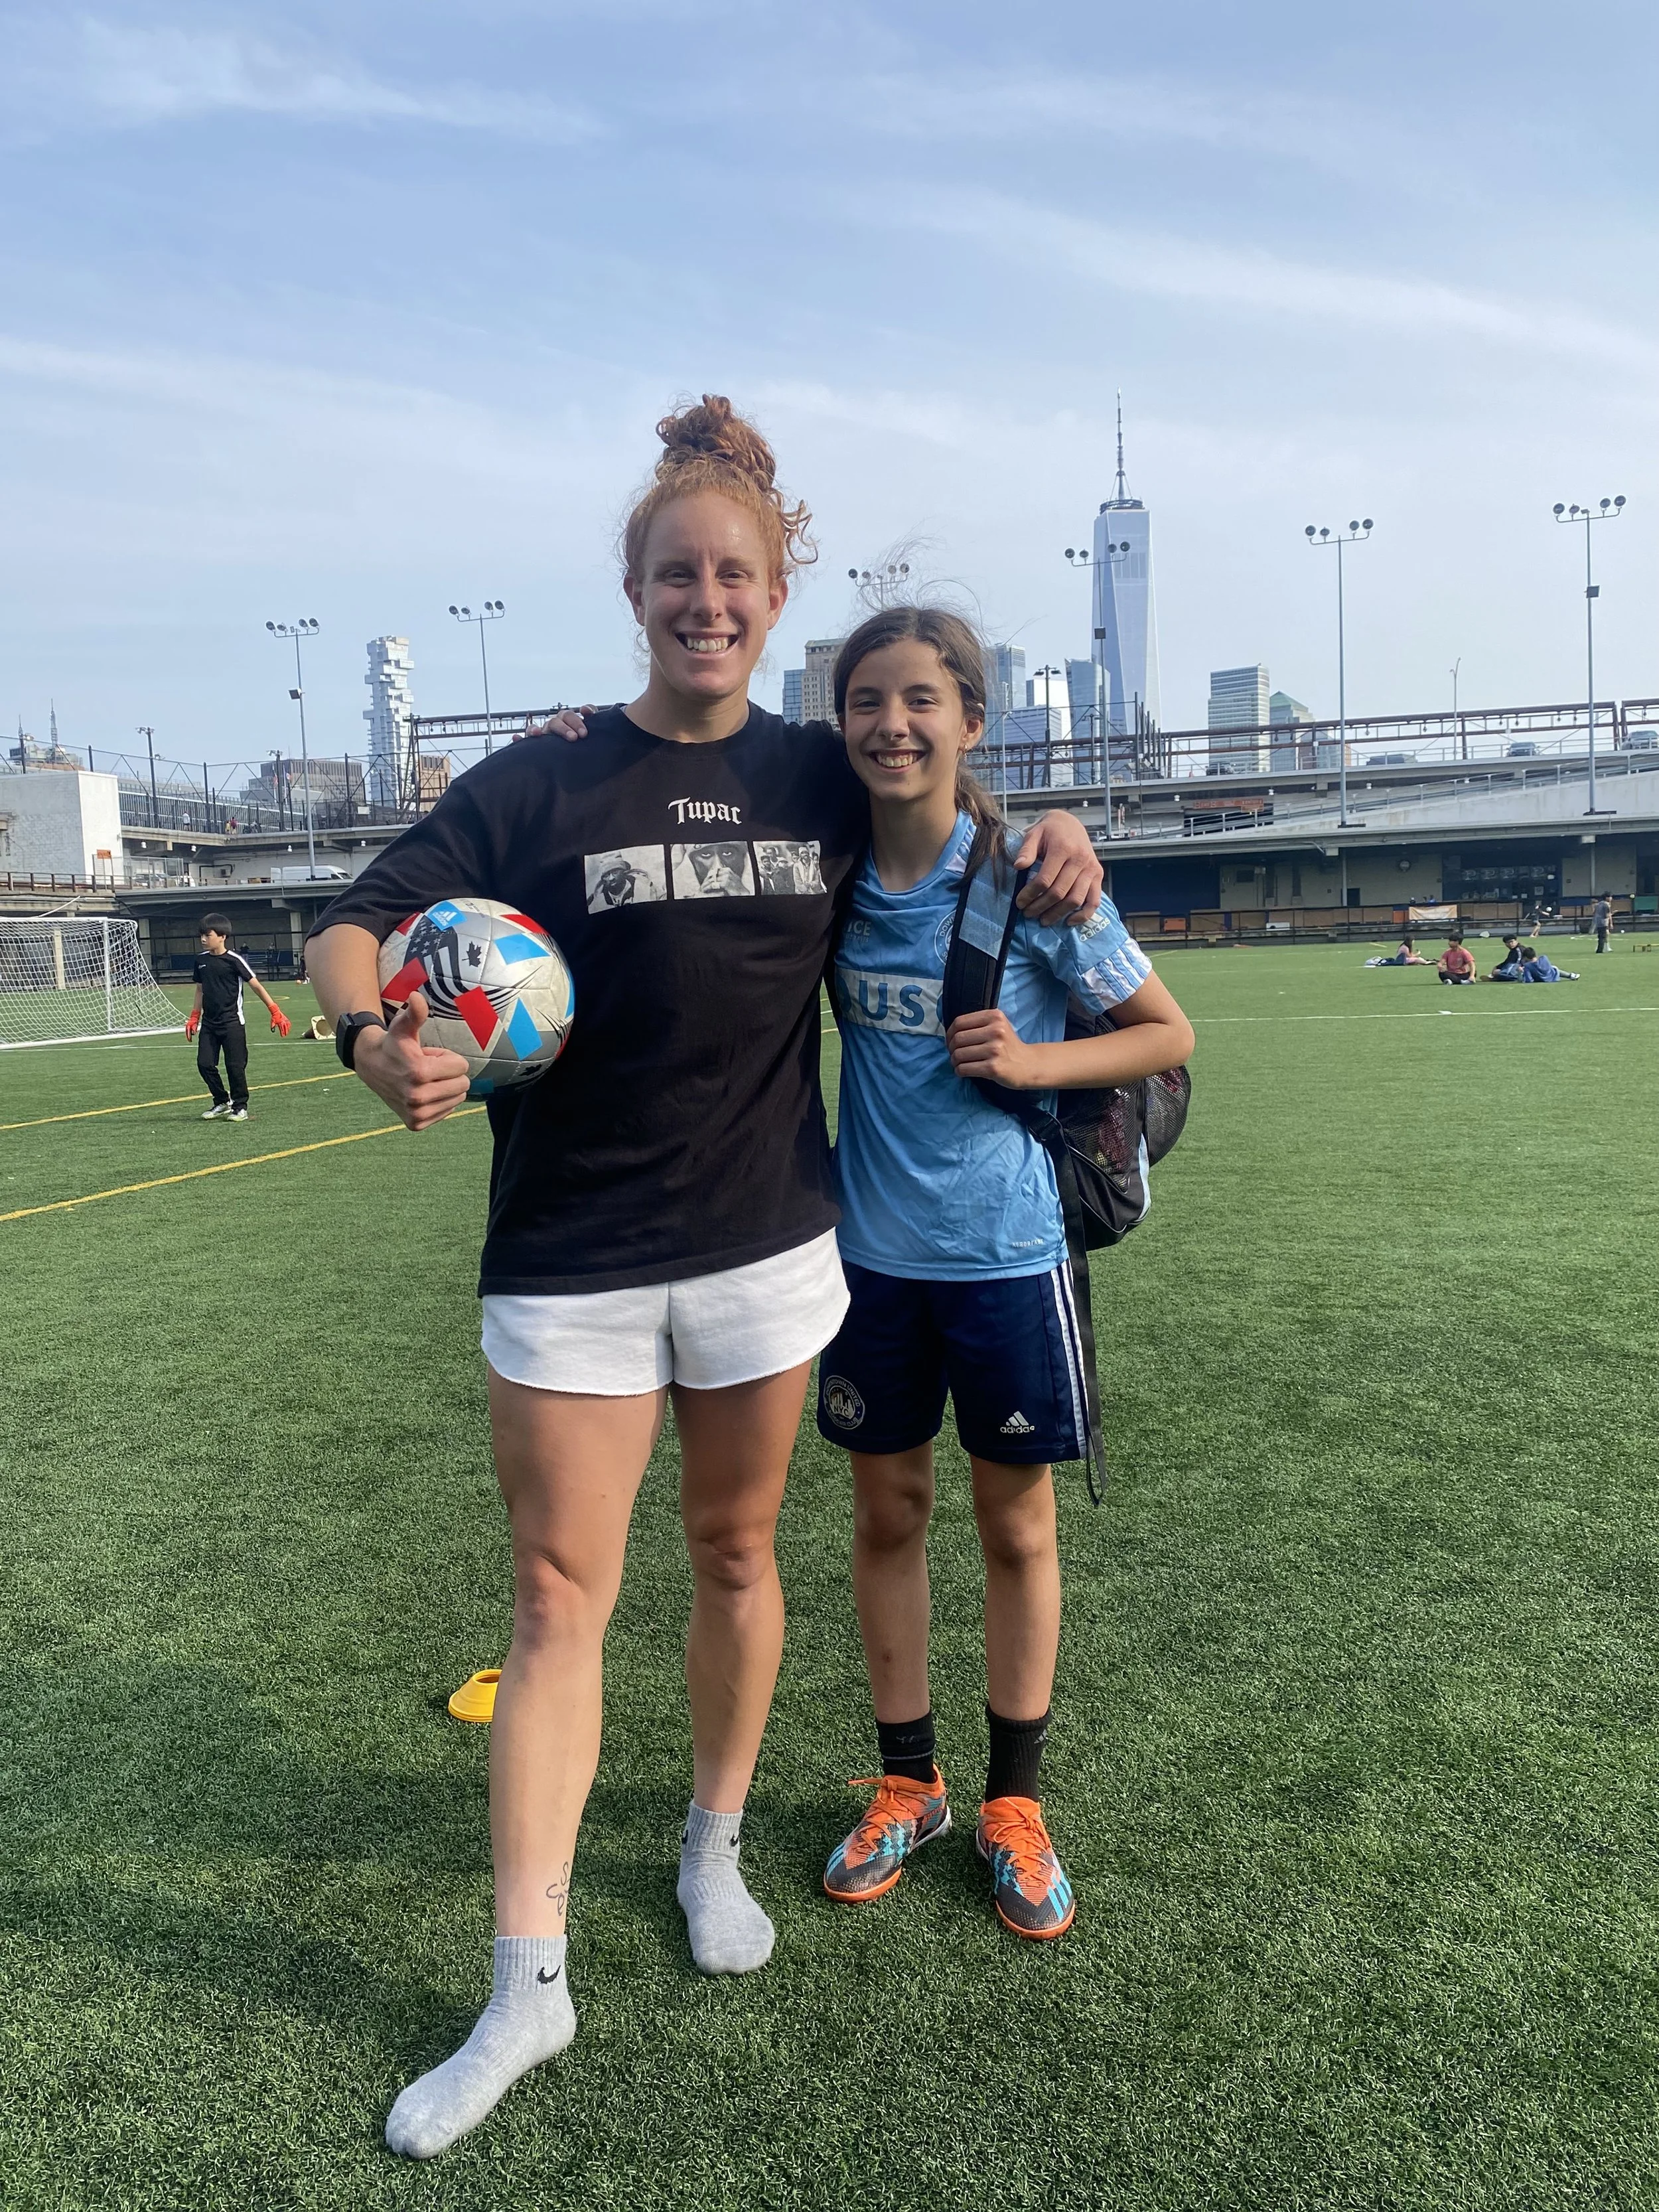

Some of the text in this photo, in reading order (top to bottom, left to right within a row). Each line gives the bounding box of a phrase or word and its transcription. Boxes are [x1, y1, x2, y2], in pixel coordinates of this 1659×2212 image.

[668, 796, 742, 825] Tupac
[1080, 917, 1111, 942] adidas
[833, 1405, 849, 1417] NYC
